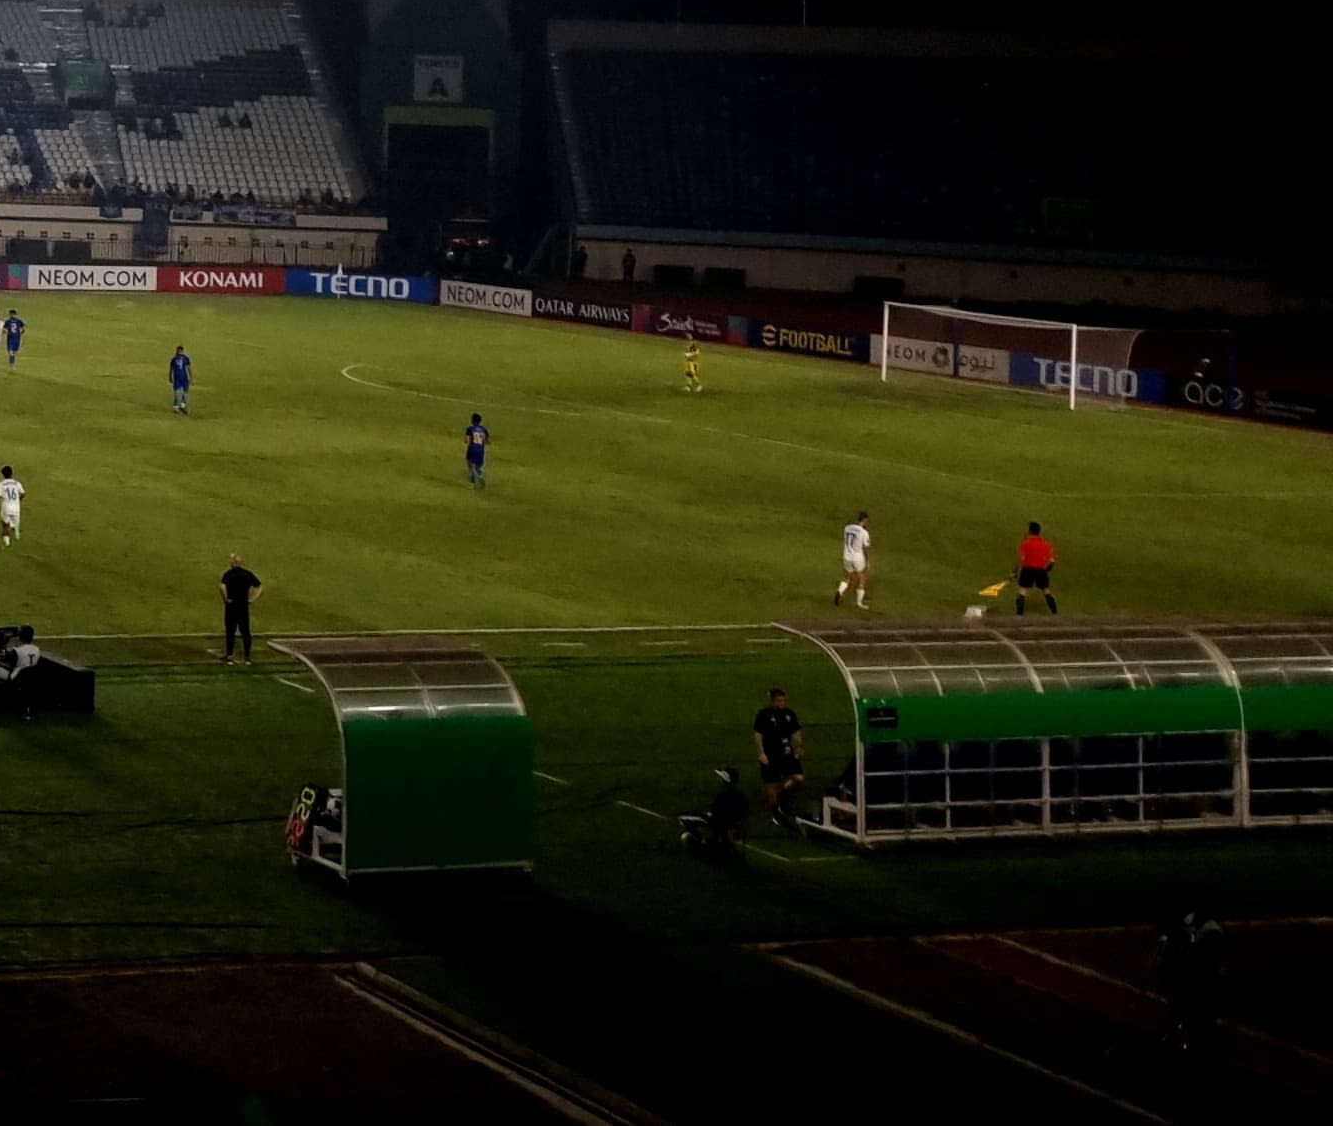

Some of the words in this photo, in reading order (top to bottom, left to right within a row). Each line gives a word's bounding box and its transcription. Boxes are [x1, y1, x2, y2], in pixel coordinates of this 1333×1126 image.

[38, 270, 147, 286] NEOM.COM
[180, 271, 263, 288] KONAMI
[309, 272, 410, 299] TECNO
[447, 283, 525, 311] NEOM.COM
[535, 298, 574, 317] QATAR
[579, 302, 630, 323] AIRWAYS
[887, 345, 925, 362] EOM
[1033, 357, 1138, 398] TECNO
